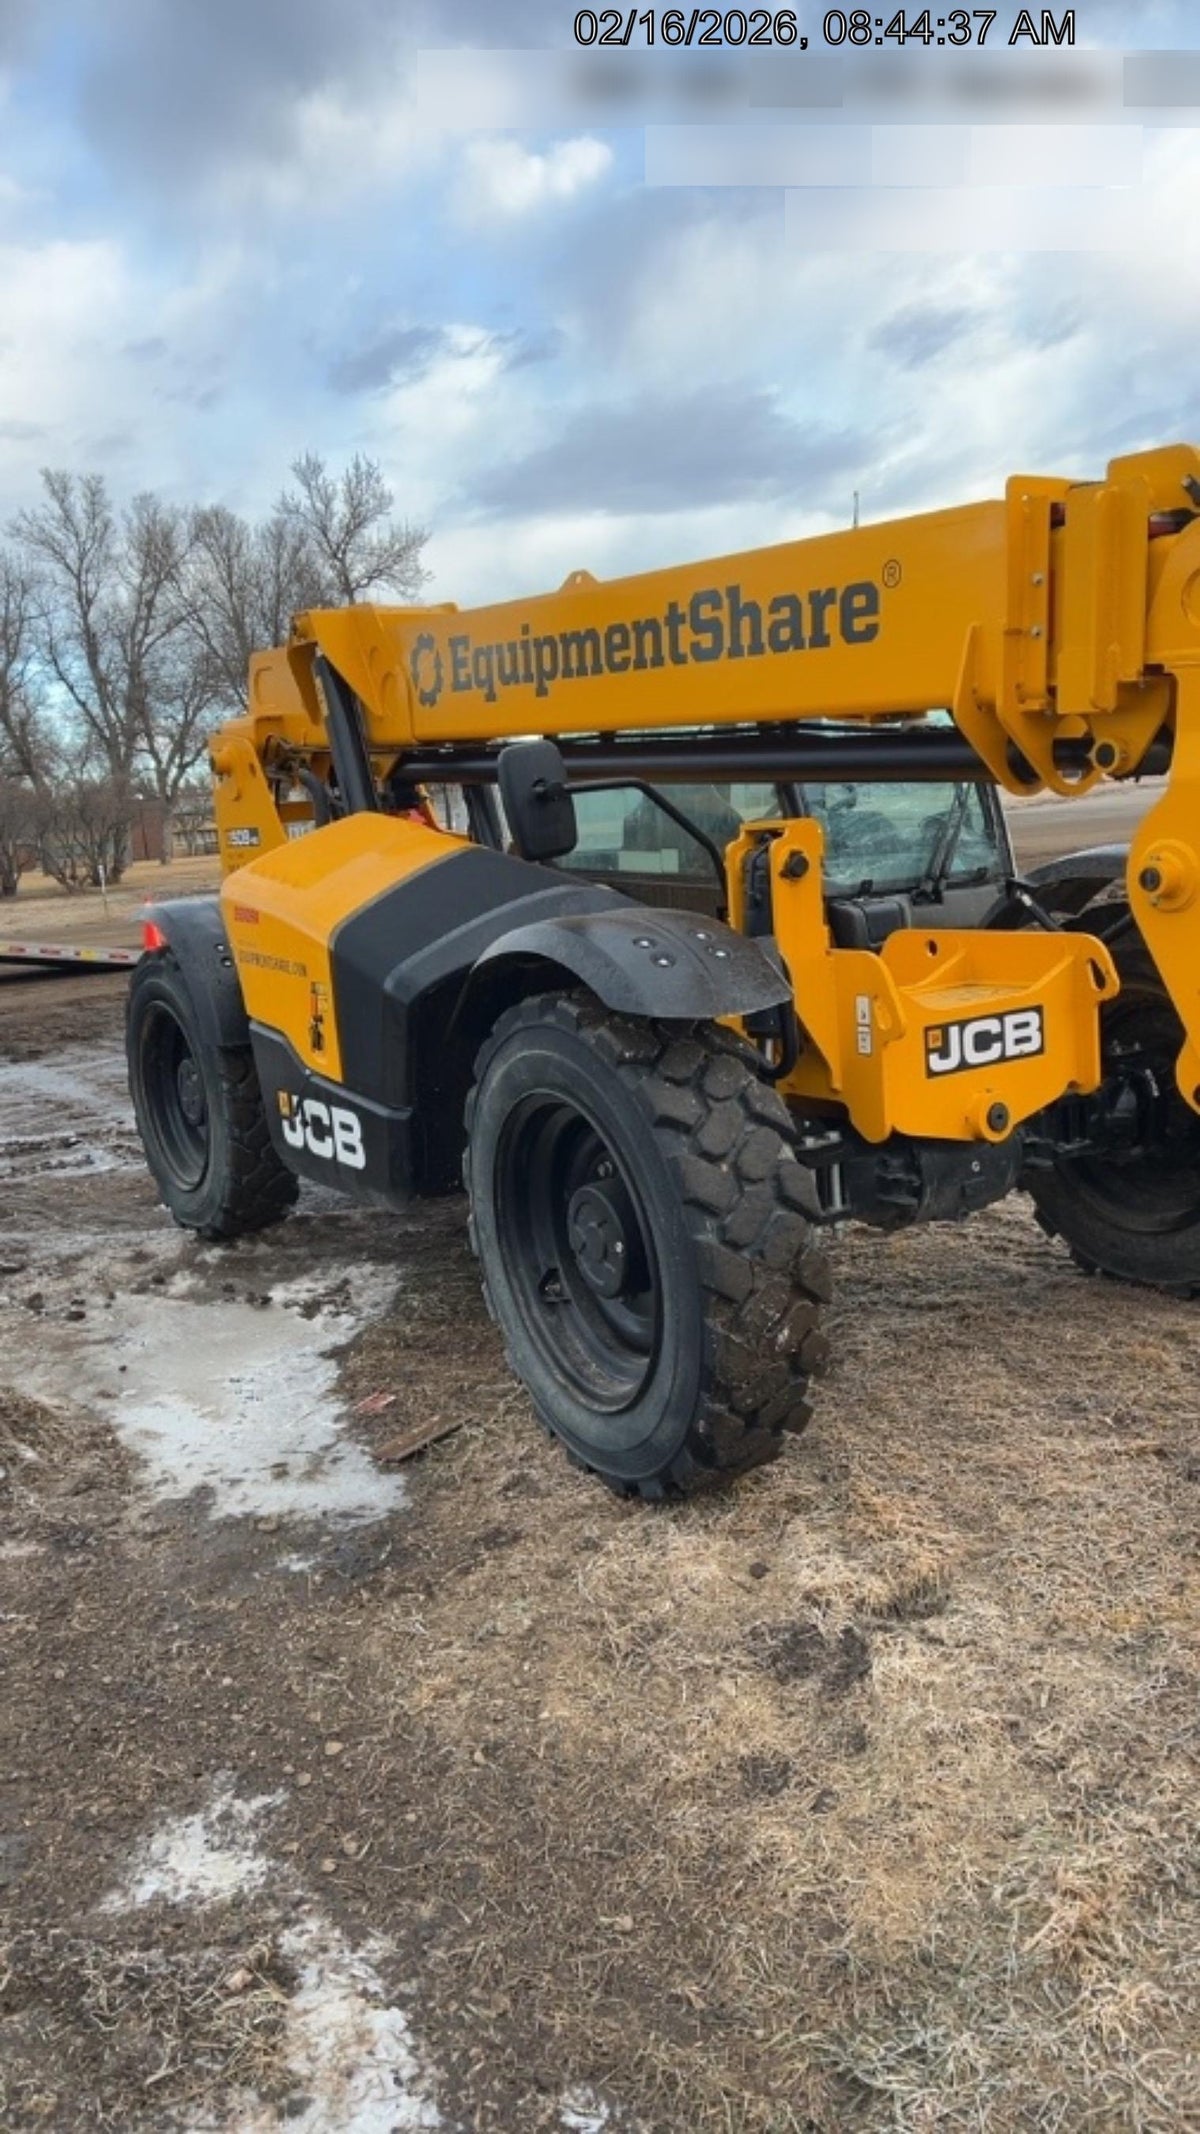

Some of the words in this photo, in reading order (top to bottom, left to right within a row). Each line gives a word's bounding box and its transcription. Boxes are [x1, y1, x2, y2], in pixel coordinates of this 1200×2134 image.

[448, 581, 880, 702] EquipmentShare
[928, 1010, 1042, 1073] JCB
[282, 1093, 366, 1170] JCB
